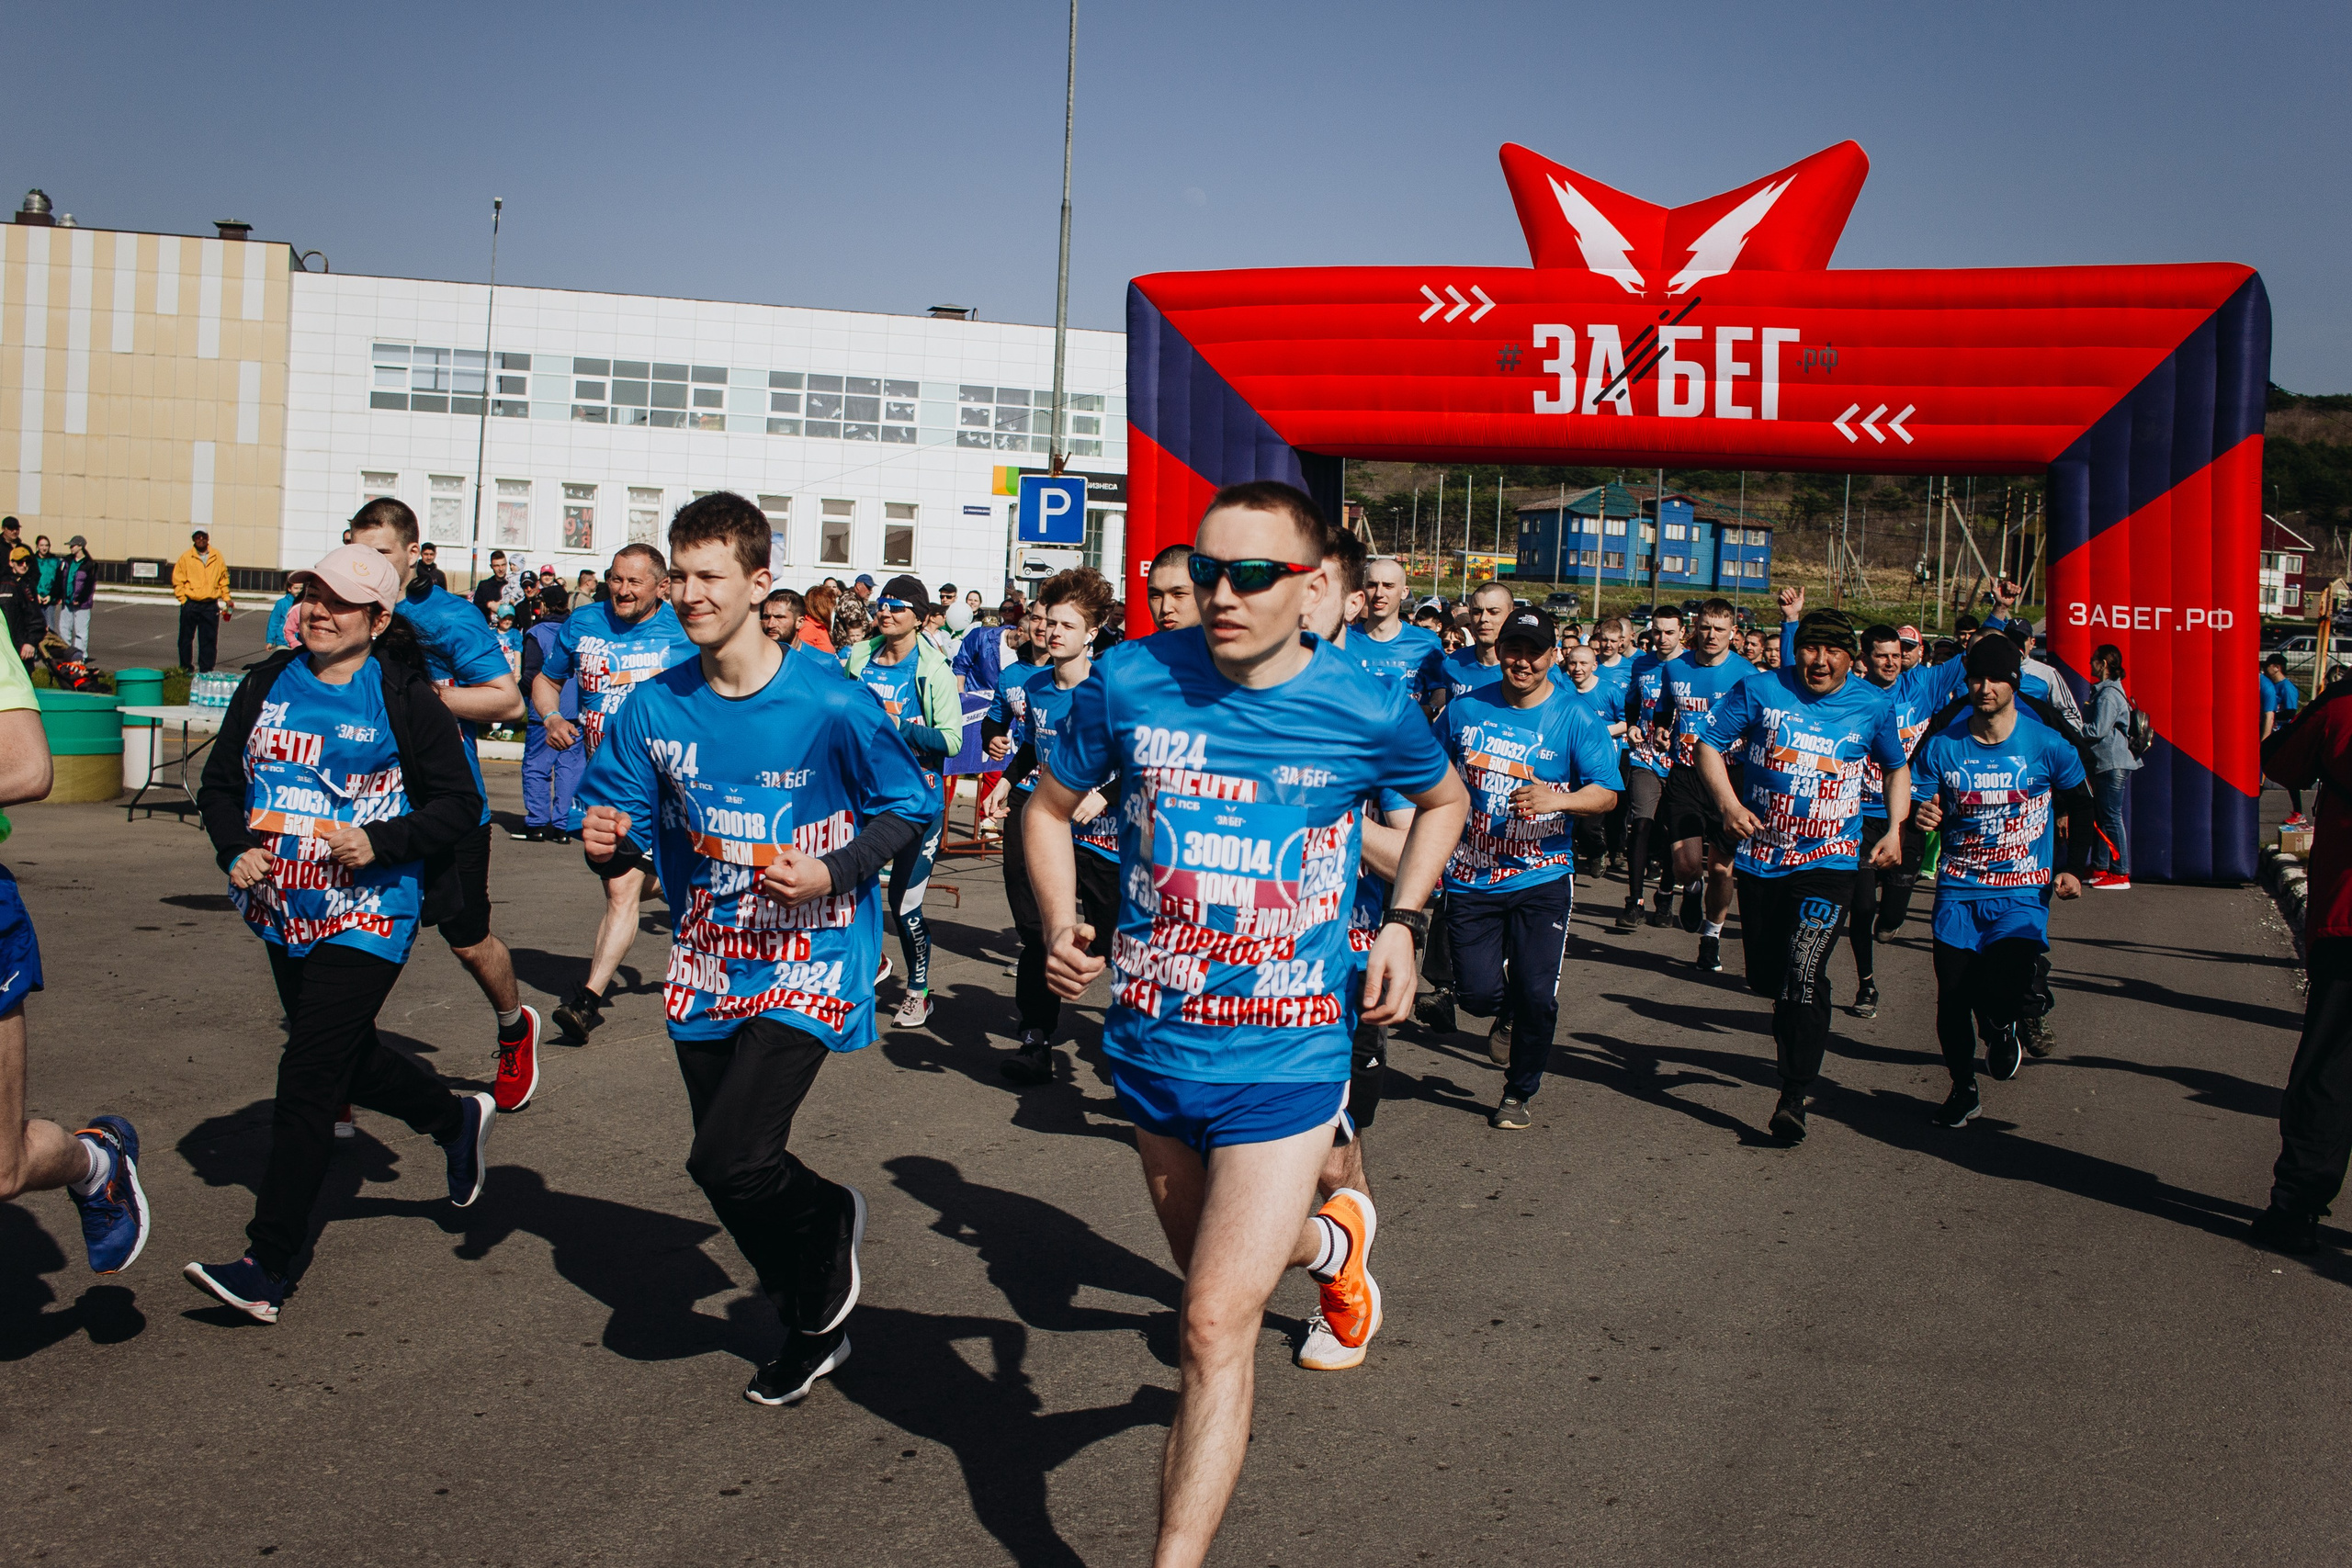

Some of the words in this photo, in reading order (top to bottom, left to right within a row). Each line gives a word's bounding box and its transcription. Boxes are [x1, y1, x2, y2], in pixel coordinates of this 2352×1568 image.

[1039, 488, 1071, 534] P
[2068, 602, 2233, 632] ЗАБЕГ.РФ
[620, 652, 659, 669] 20008
[967, 710, 988, 723] ЗАБЕГ.Р
[1134, 726, 1207, 771] 2024
[1461, 725, 1477, 747] 20
[1484, 735, 1526, 761] 20032
[1791, 731, 1834, 755] 20033
[646, 739, 699, 781] 024
[1789, 775, 1841, 800] #ЗАБЕГ
[1944, 772, 1961, 788] 20
[1973, 772, 2013, 789] 30012
[275, 785, 331, 816] 20031
[1178, 799, 1201, 811] ПСБ
[1751, 784, 1795, 815] #ЗАБЕГ
[706, 807, 765, 840] 20018
[1091, 816, 1118, 835] 202
[1505, 818, 1566, 841] #МОМЕНТ
[1182, 831, 1272, 874] 30014
[1467, 829, 1544, 858] #ГОРДОСТЬ
[1780, 838, 1860, 866] #ЕДИНСТВО
[1976, 867, 2051, 887] #ЕДИНСТВО
[908, 916, 927, 983] AUTHENTIC
[773, 961, 844, 996] 2024
[1252, 959, 1325, 998] 2024
[1182, 992, 1343, 1028] #ЕДИНСТВО
